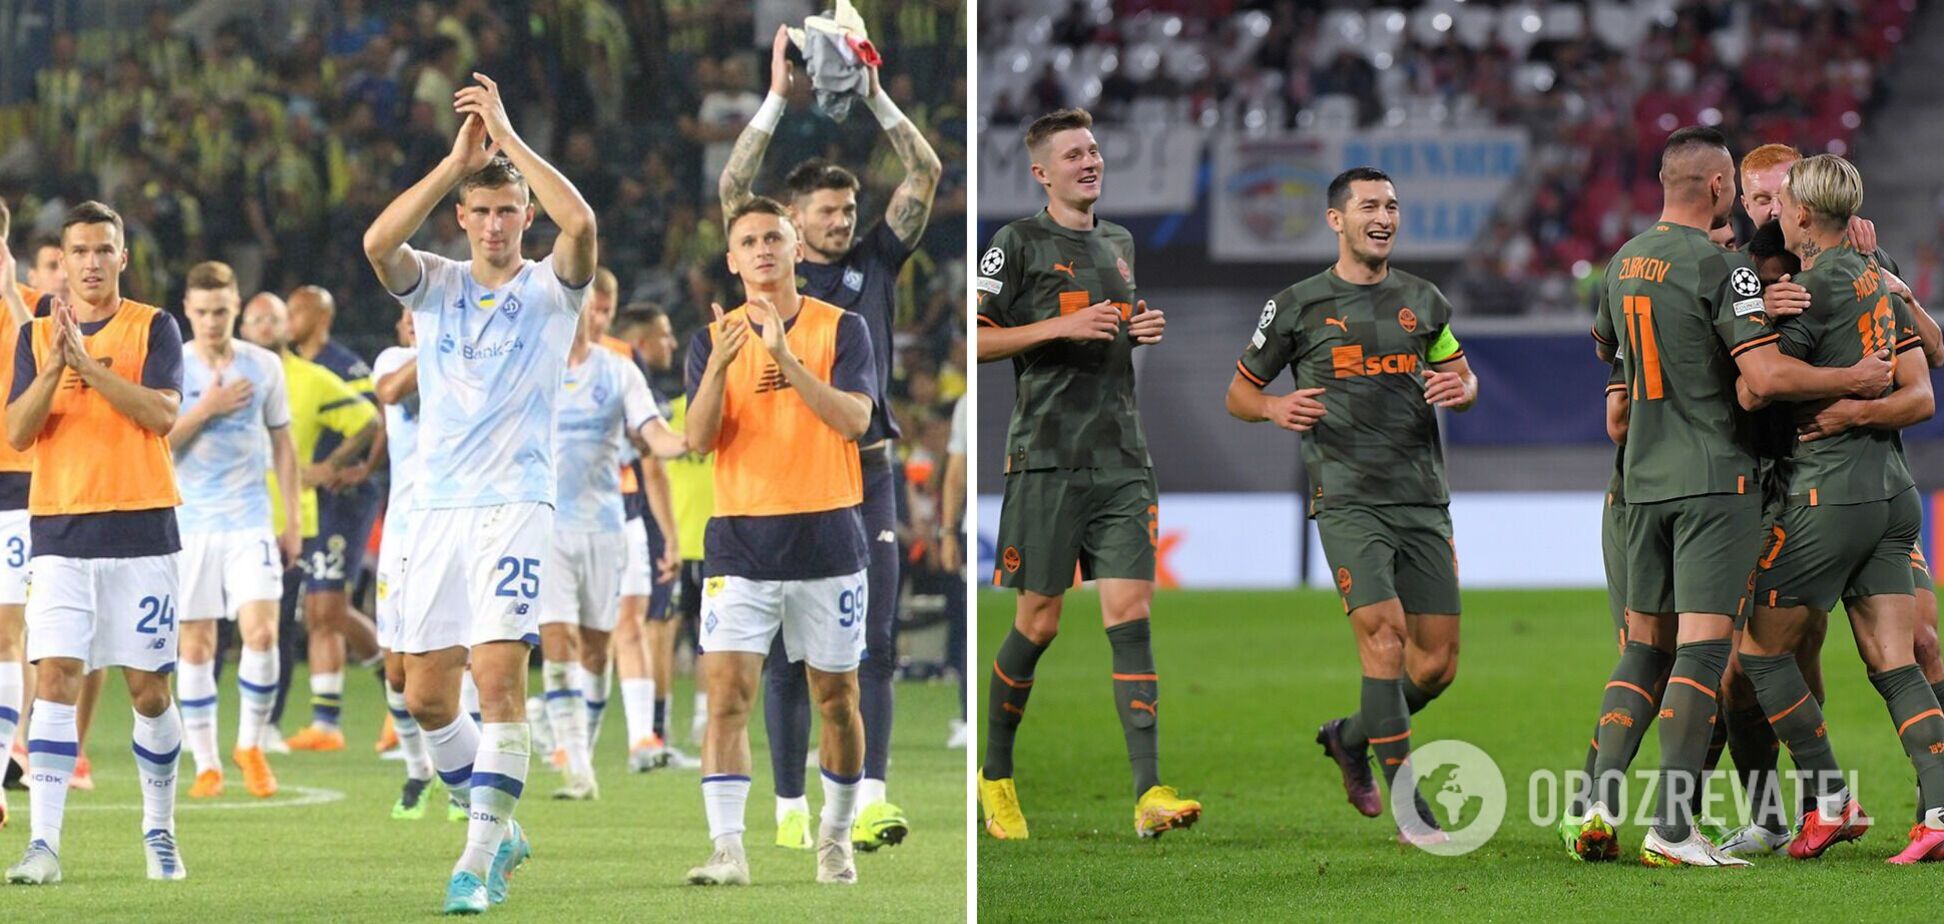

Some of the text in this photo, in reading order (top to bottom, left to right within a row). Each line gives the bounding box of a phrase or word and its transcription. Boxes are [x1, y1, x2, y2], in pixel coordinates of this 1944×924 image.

[1619, 256, 1671, 283] ZUBKOV
[1364, 354, 1418, 376] SCM
[1623, 295, 1664, 401] 11
[312, 551, 345, 580] 32
[495, 556, 541, 599] 25
[136, 594, 174, 634] 24
[839, 584, 864, 628] 99
[32, 774, 63, 784] CDK
